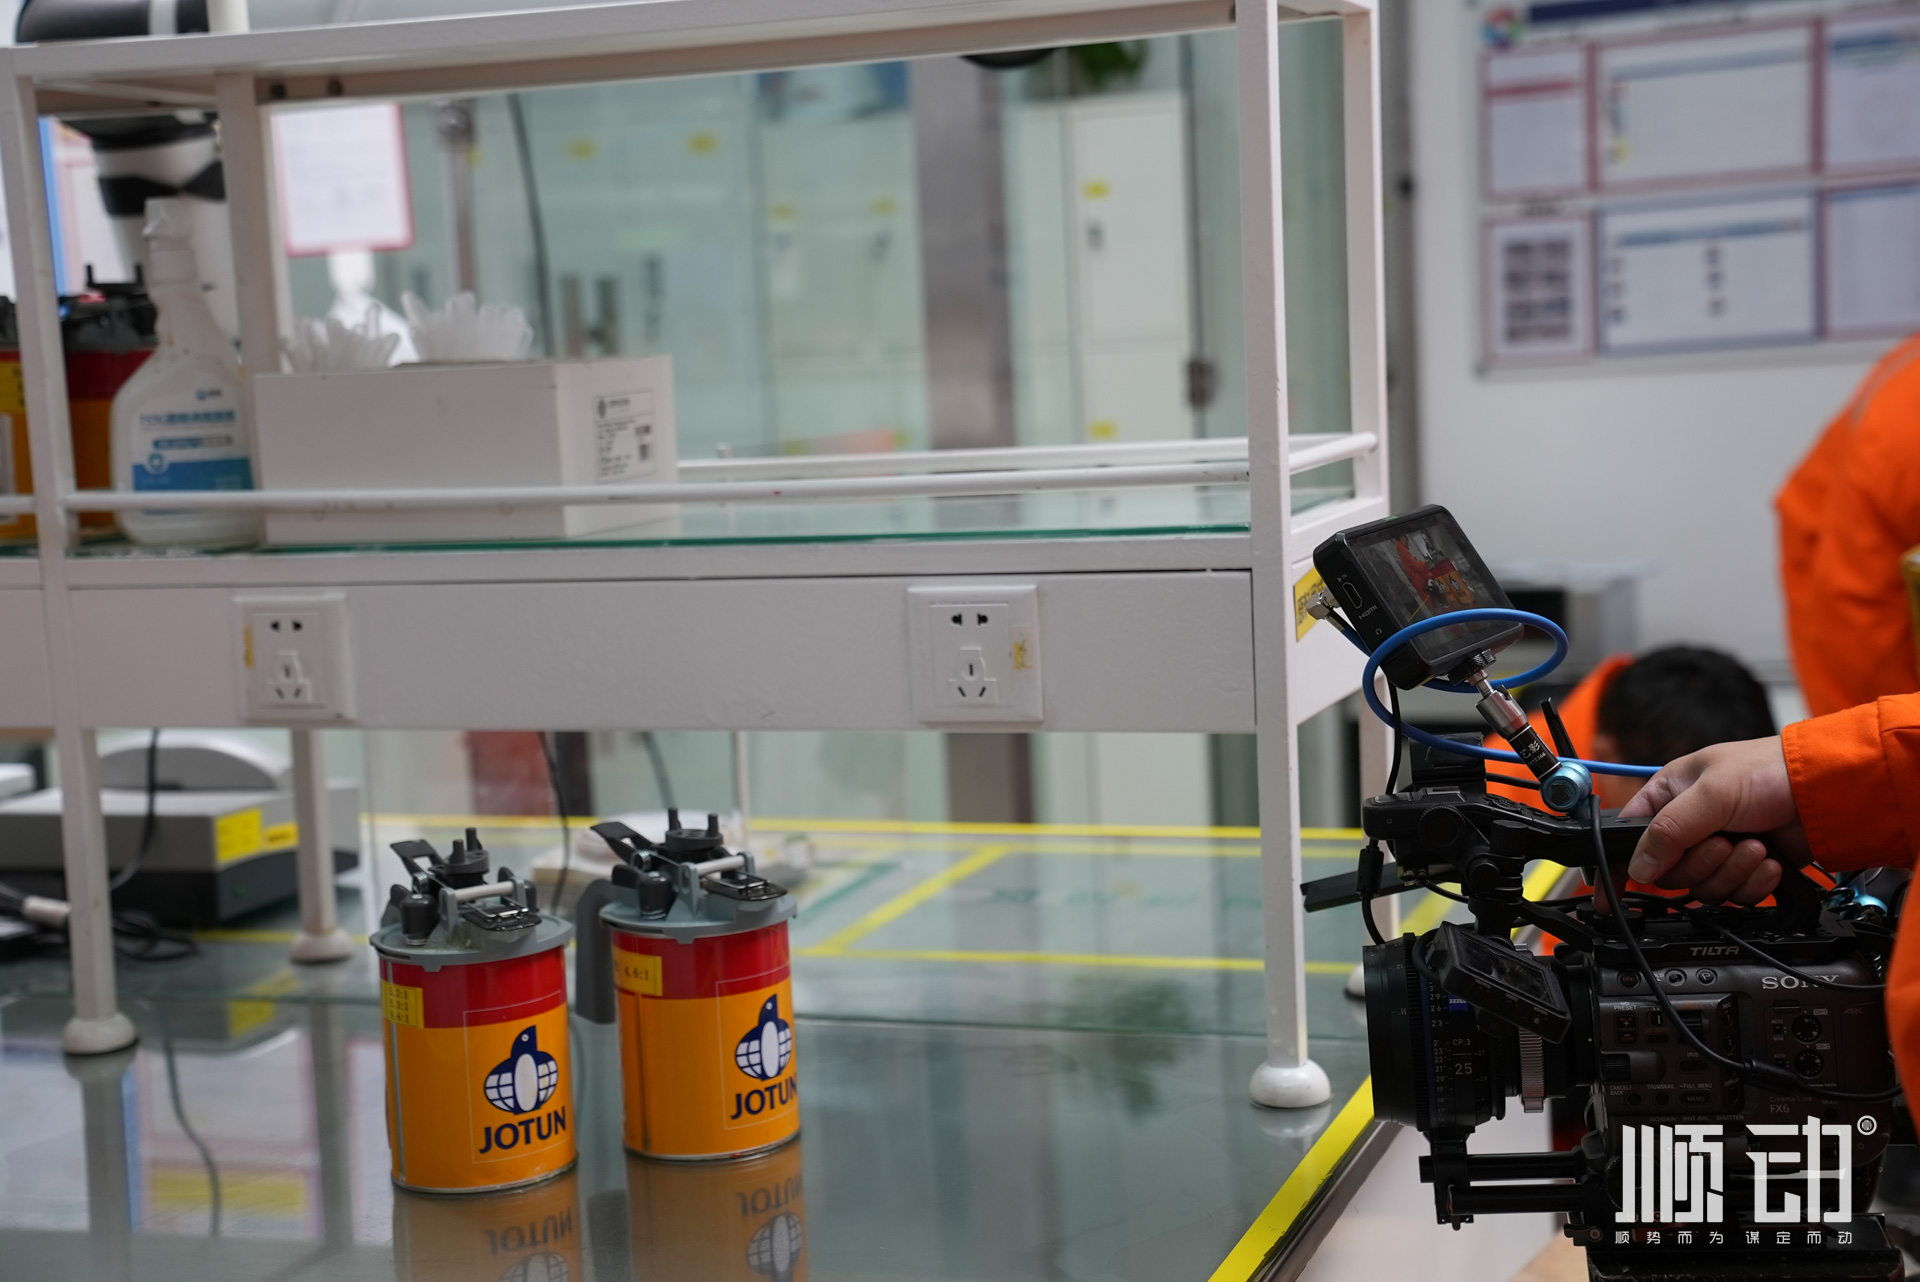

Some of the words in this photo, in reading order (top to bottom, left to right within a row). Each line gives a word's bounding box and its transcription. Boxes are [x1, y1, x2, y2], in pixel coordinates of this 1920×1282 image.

[1358, 604, 1378, 620] HDMI
[1690, 945, 1740, 957] TILTA
[1454, 1062, 1473, 1075] 25
[1769, 1103, 1790, 1113] FX6
[479, 1106, 567, 1154] JOTUN
